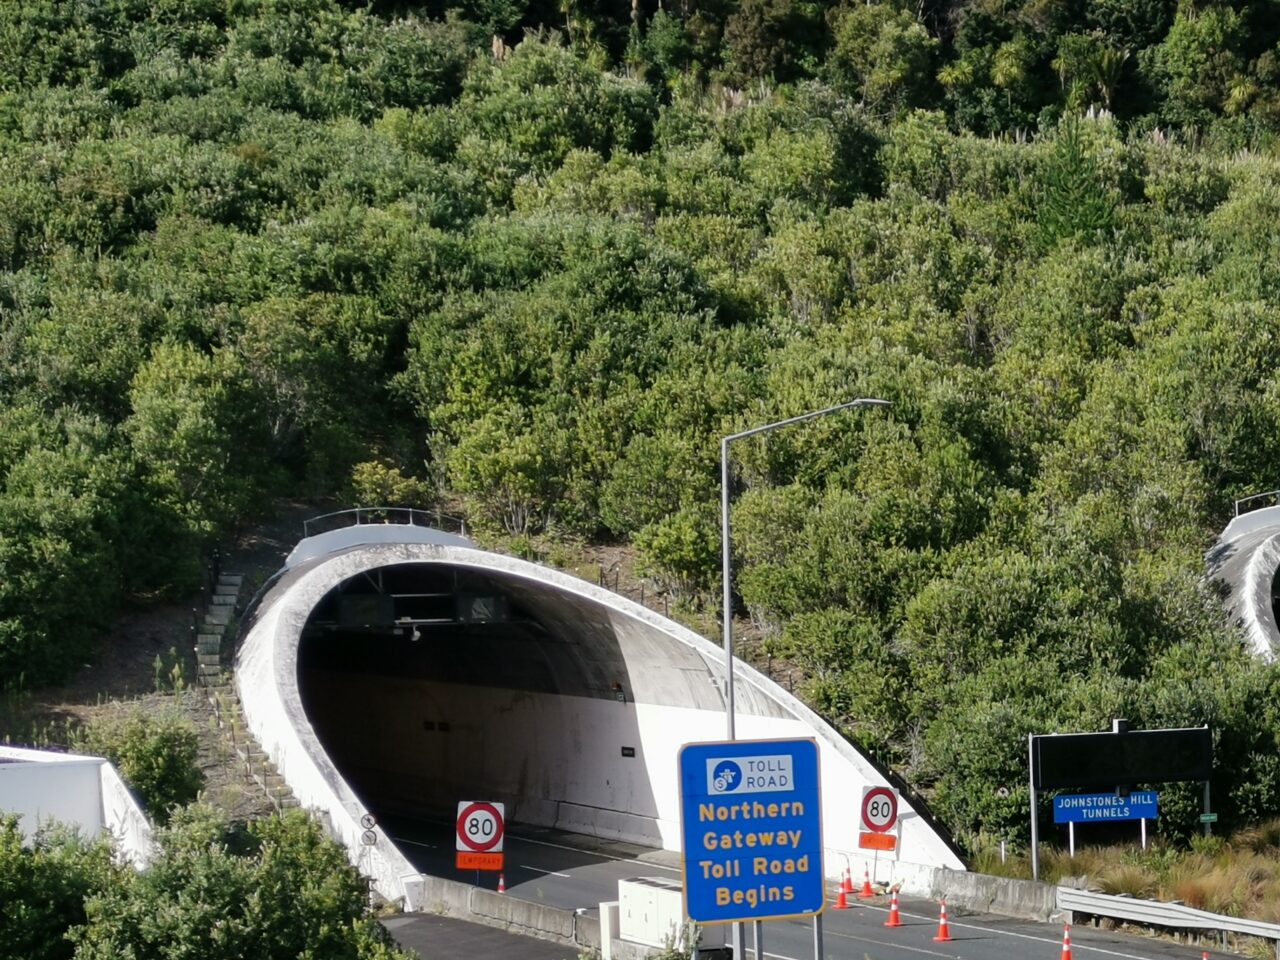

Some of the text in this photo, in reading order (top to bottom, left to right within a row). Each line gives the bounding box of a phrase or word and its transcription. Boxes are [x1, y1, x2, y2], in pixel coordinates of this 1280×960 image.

[747, 760, 786, 772] TOLL
[747, 775, 788, 788] ROAD
[870, 801, 890, 818] 80
[1058, 795, 1153, 808] JOHNSTONES HILL
[699, 801, 804, 822] Northern
[1082, 807, 1130, 818] TUNNELS
[468, 817, 493, 836] 80
[703, 830, 802, 850] Gateway
[699, 855, 809, 879] Toll Road
[716, 884, 794, 908] Begins
